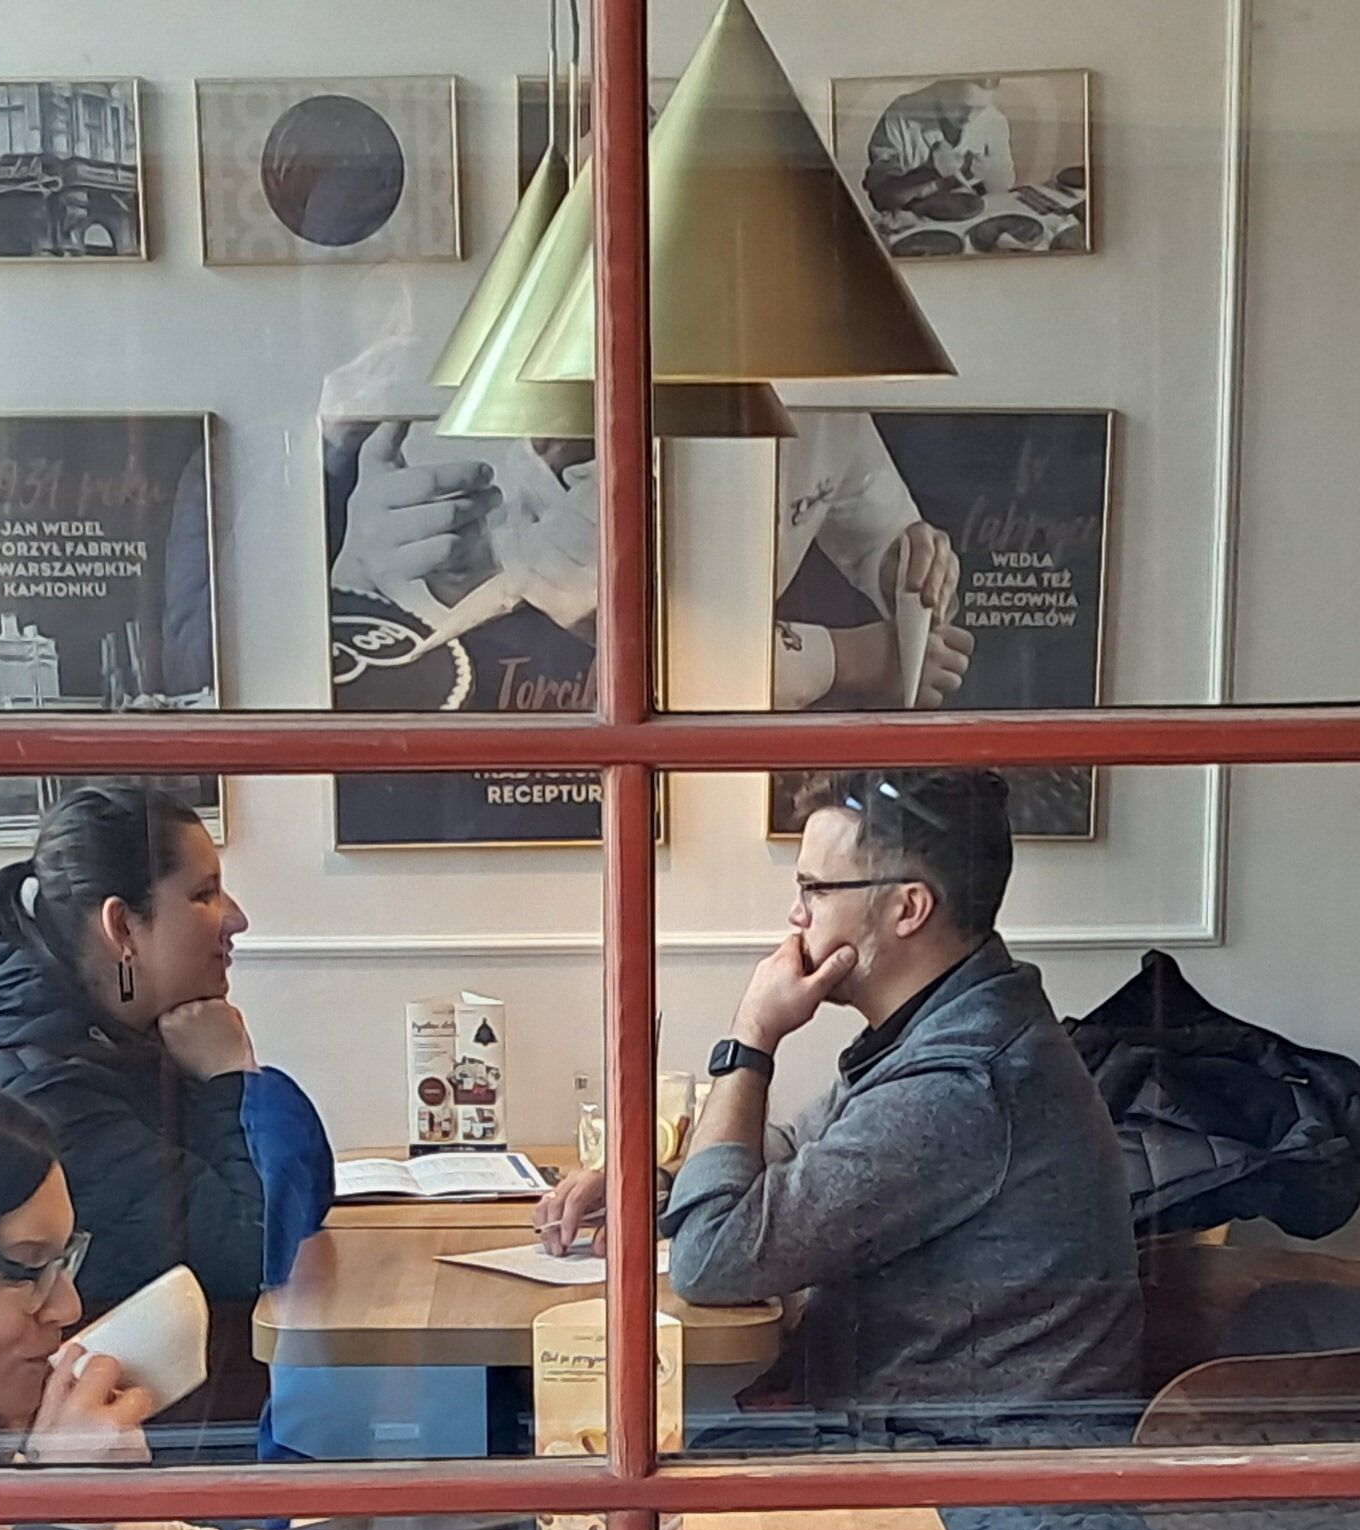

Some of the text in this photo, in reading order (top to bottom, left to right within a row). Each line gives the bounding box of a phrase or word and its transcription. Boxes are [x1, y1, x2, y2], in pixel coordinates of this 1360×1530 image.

[0, 520, 105, 537] JAN WEDEL
[65, 541, 147, 560] FABRYKĘ
[992, 551, 1055, 567] WEDLA
[3, 581, 107, 598] KAMIONKU
[964, 591, 1079, 608] PRACOWNIA
[965, 606, 1077, 628] RARYTASÓW
[487, 784, 602, 804] RECEPTUR
